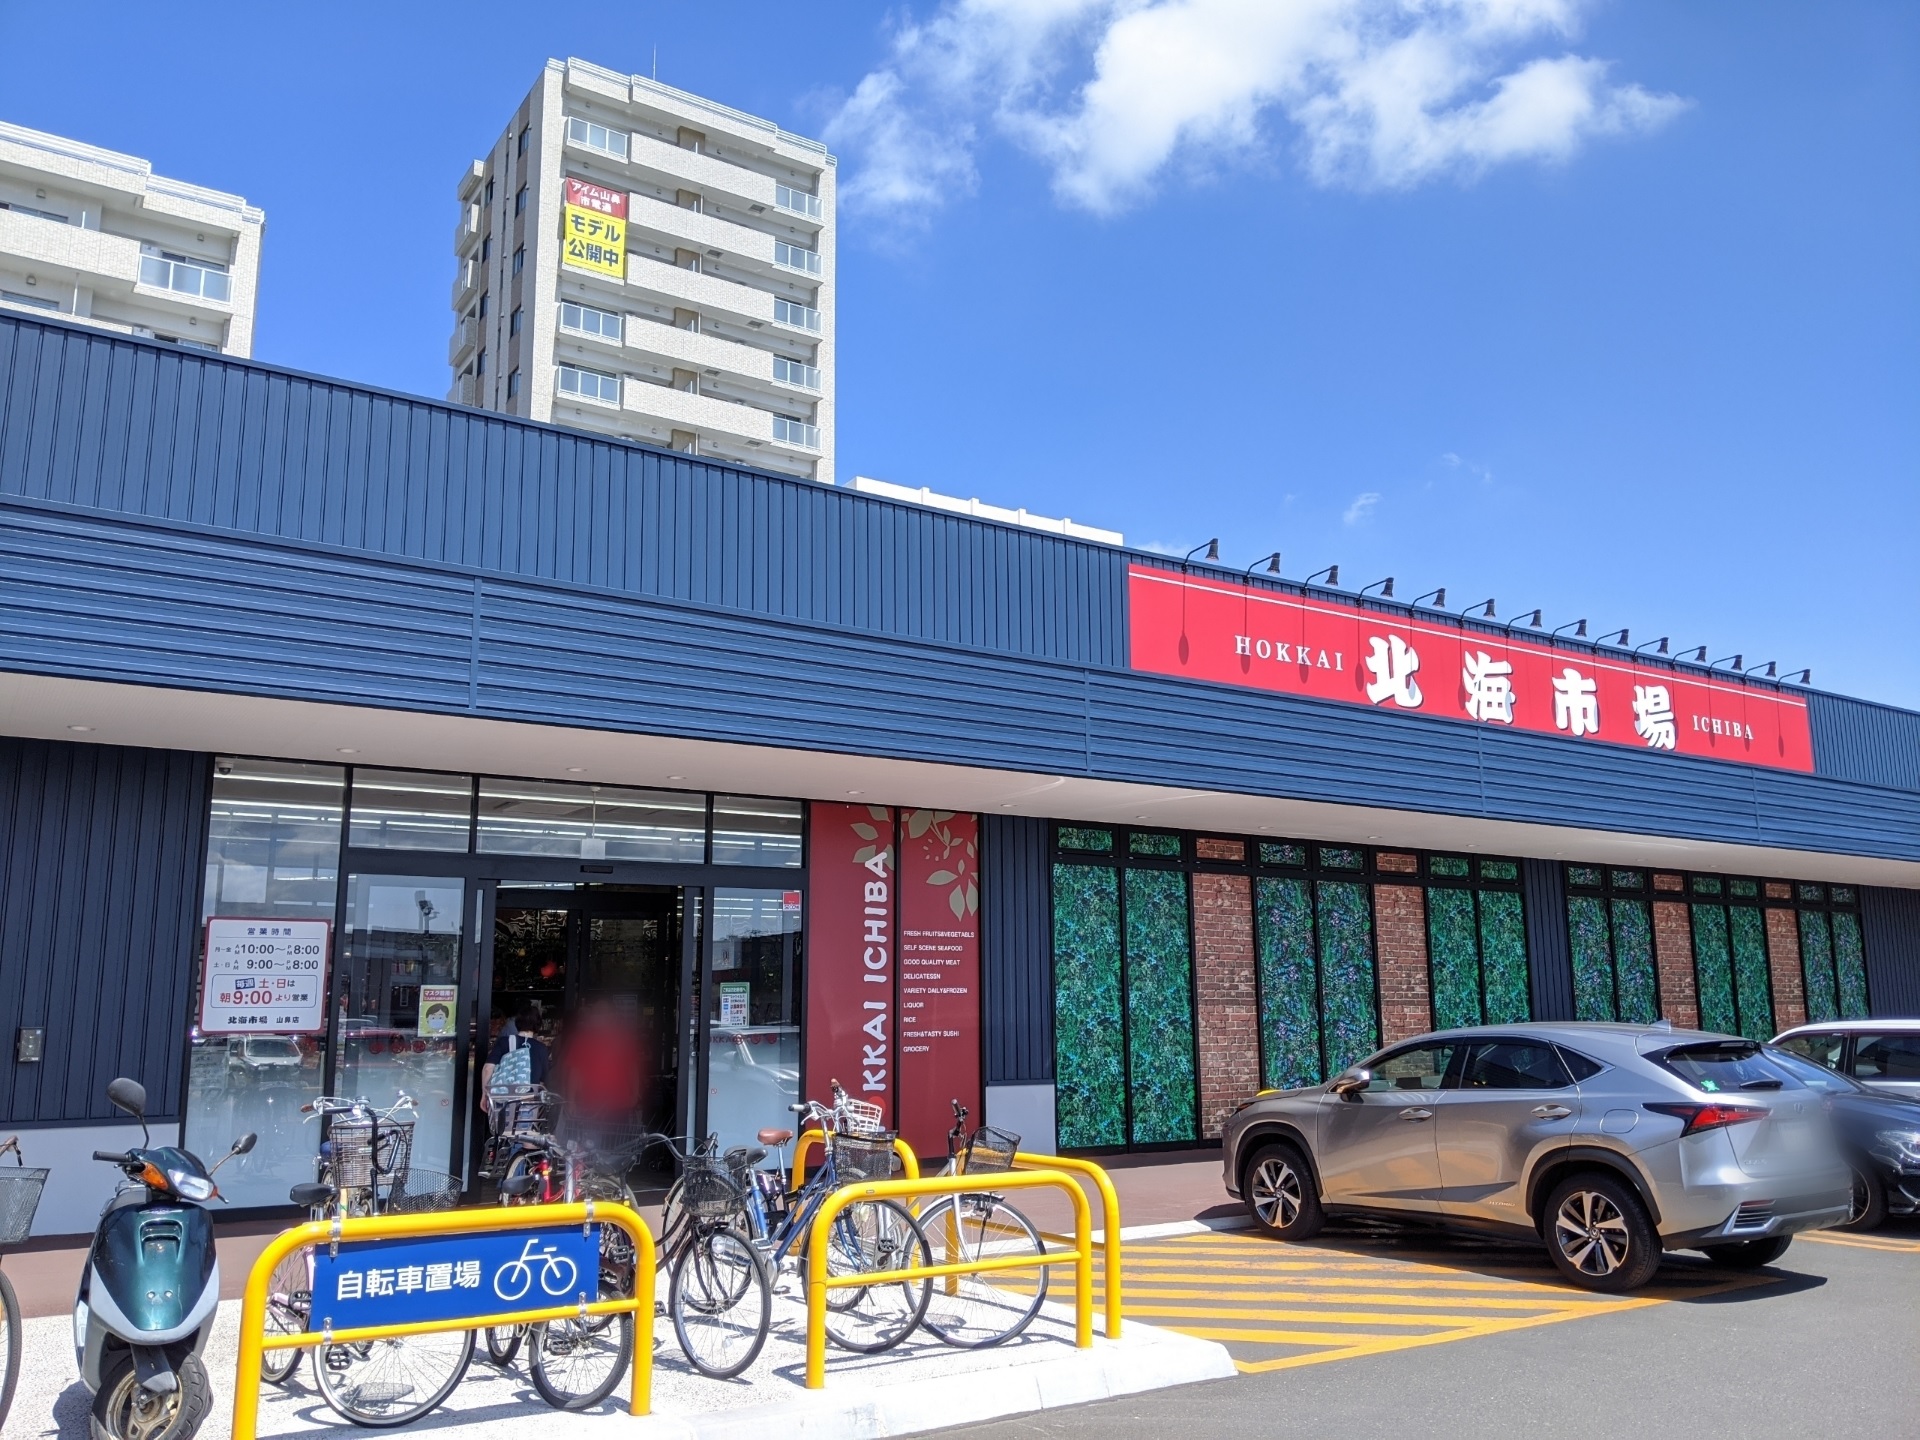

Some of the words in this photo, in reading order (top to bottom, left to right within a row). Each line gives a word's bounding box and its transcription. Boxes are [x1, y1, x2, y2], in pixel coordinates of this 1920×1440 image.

[571, 213, 621, 242] モデル
[568, 237, 619, 267] 公開中
[1235, 634, 1343, 671] HOKKAI
[1365, 634, 1676, 750] 北海市場
[1692, 714, 1754, 740] ICHIBA
[863, 852, 887, 983] ICHIBA
[247, 927, 292, 936] 営業時間
[293, 945, 320, 955] 8:00
[292, 960, 319, 970] 8:00
[228, 1016, 268, 1025] 北海市場
[276, 1016, 300, 1024] 山鼻店
[902, 1045, 930, 1053] GROCERY
[337, 1260, 482, 1301] 自転車置場
